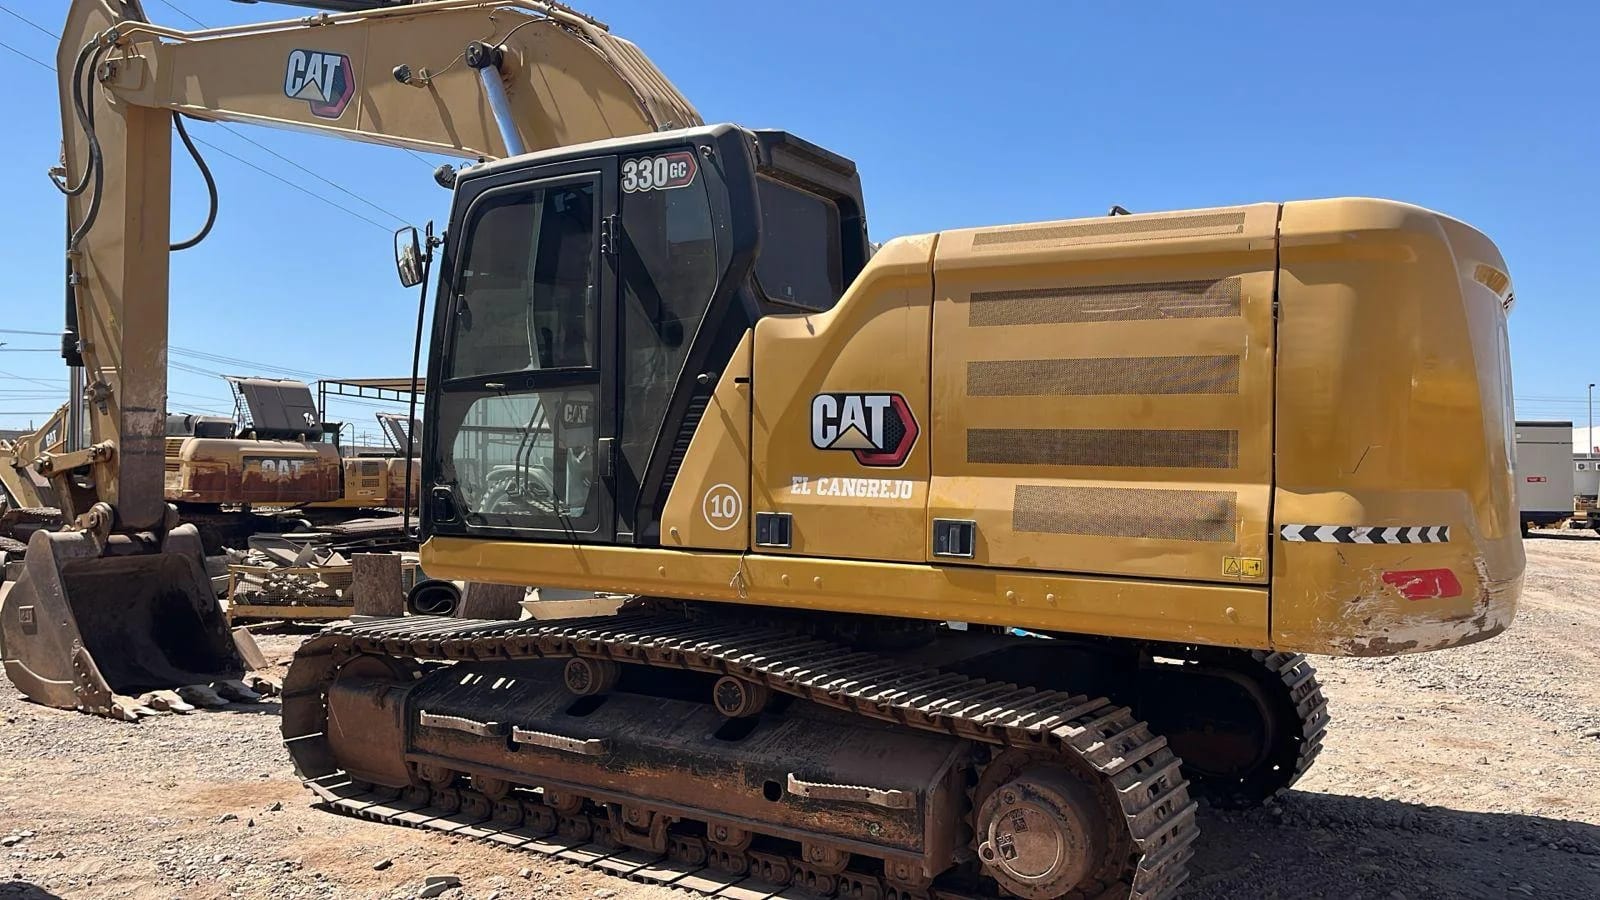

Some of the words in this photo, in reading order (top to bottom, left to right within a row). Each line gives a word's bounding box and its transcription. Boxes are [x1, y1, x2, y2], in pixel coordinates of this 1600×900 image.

[286, 50, 341, 102] CAT
[564, 403, 589, 424] CAT
[812, 394, 891, 449] CAT
[790, 476, 811, 495] EL
[816, 477, 913, 500] CANGREJO
[711, 494, 736, 519] 10
